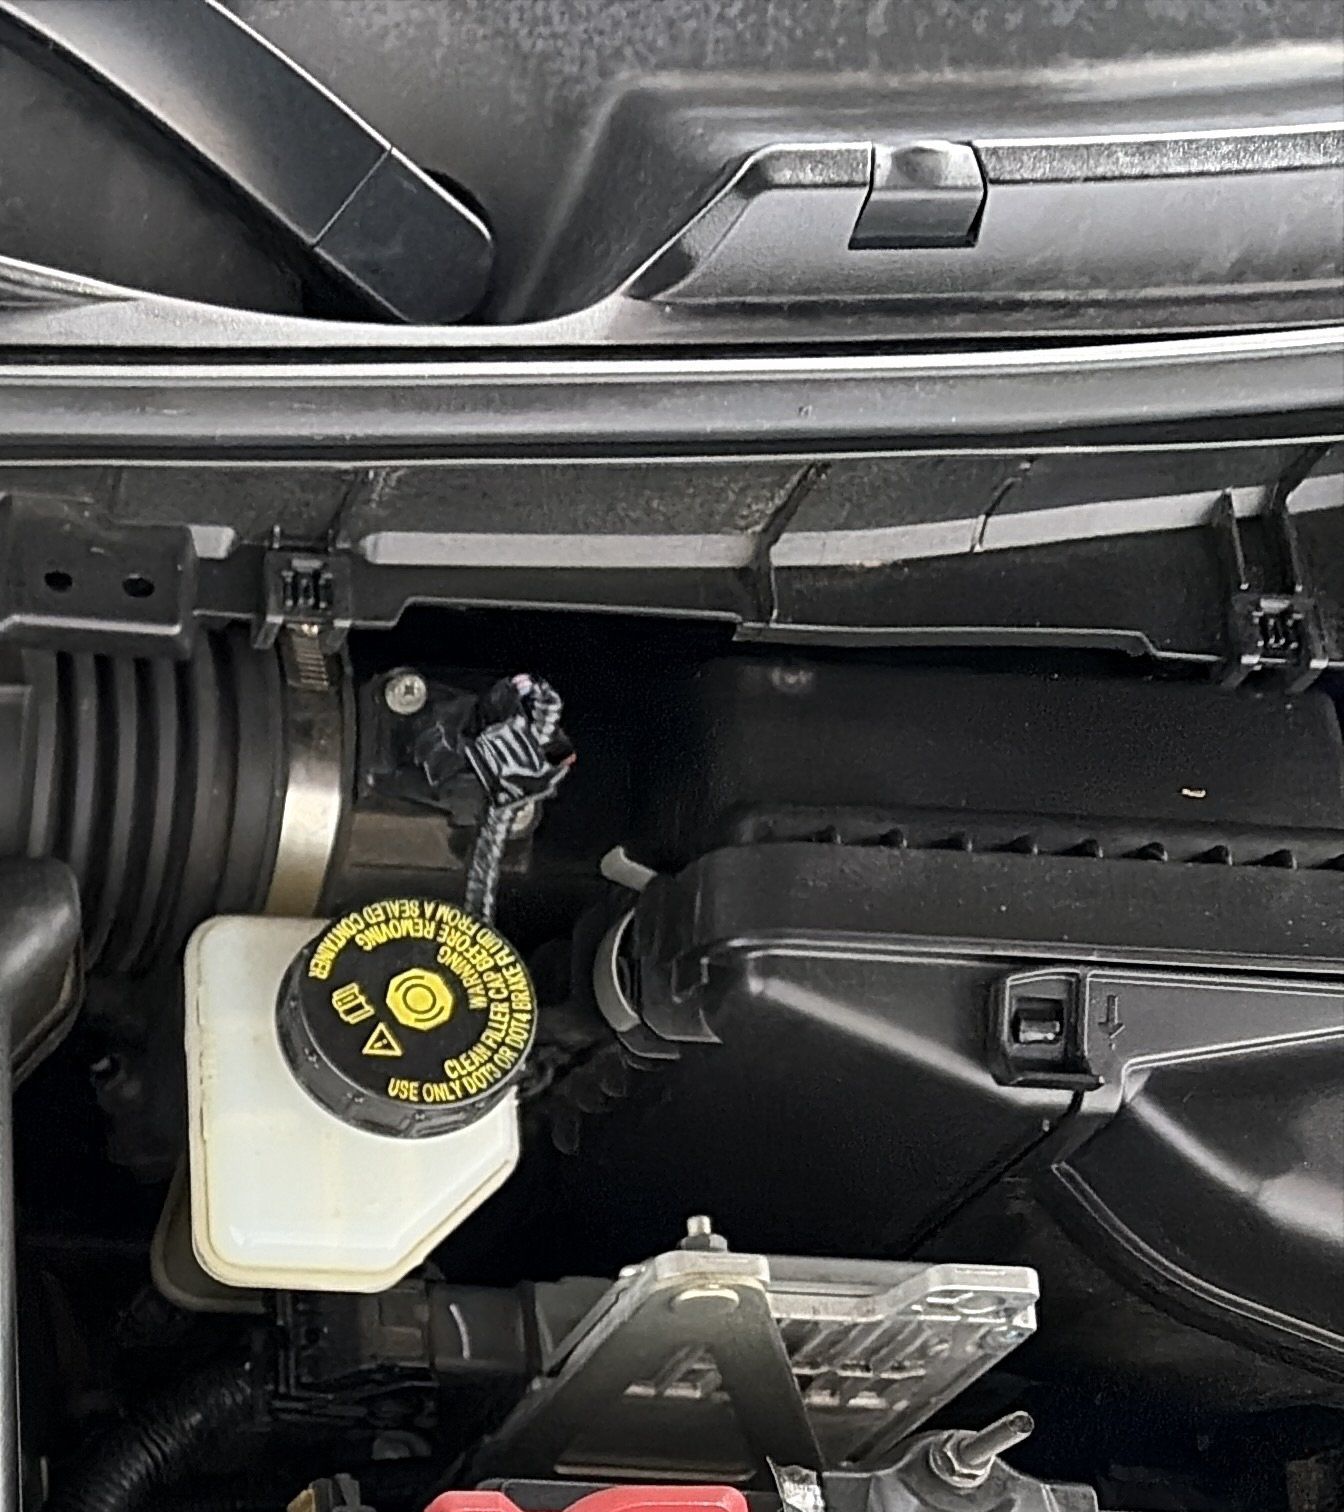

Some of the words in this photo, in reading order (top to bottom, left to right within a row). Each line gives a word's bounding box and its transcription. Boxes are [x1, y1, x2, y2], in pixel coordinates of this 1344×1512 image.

[363, 899, 420, 924] SEALED
[424, 900, 435, 919] A
[435, 904, 480, 936] FROM
[355, 918, 435, 951] REMOVING
[436, 923, 494, 972] BEFORE
[476, 928, 515, 966] FLUID
[436, 945, 487, 1010] WARNING
[483, 971, 508, 999] CAP
[502, 963, 531, 1011] BRAKE
[480, 1001, 510, 1049] FILLER
[505, 1012, 531, 1050] DOT4
[444, 1043, 492, 1079] CLEAN
[493, 1046, 518, 1069] OR
[388, 1077, 419, 1101] USE
[422, 1080, 463, 1102] ONLY
[463, 1062, 501, 1094] DOT3
